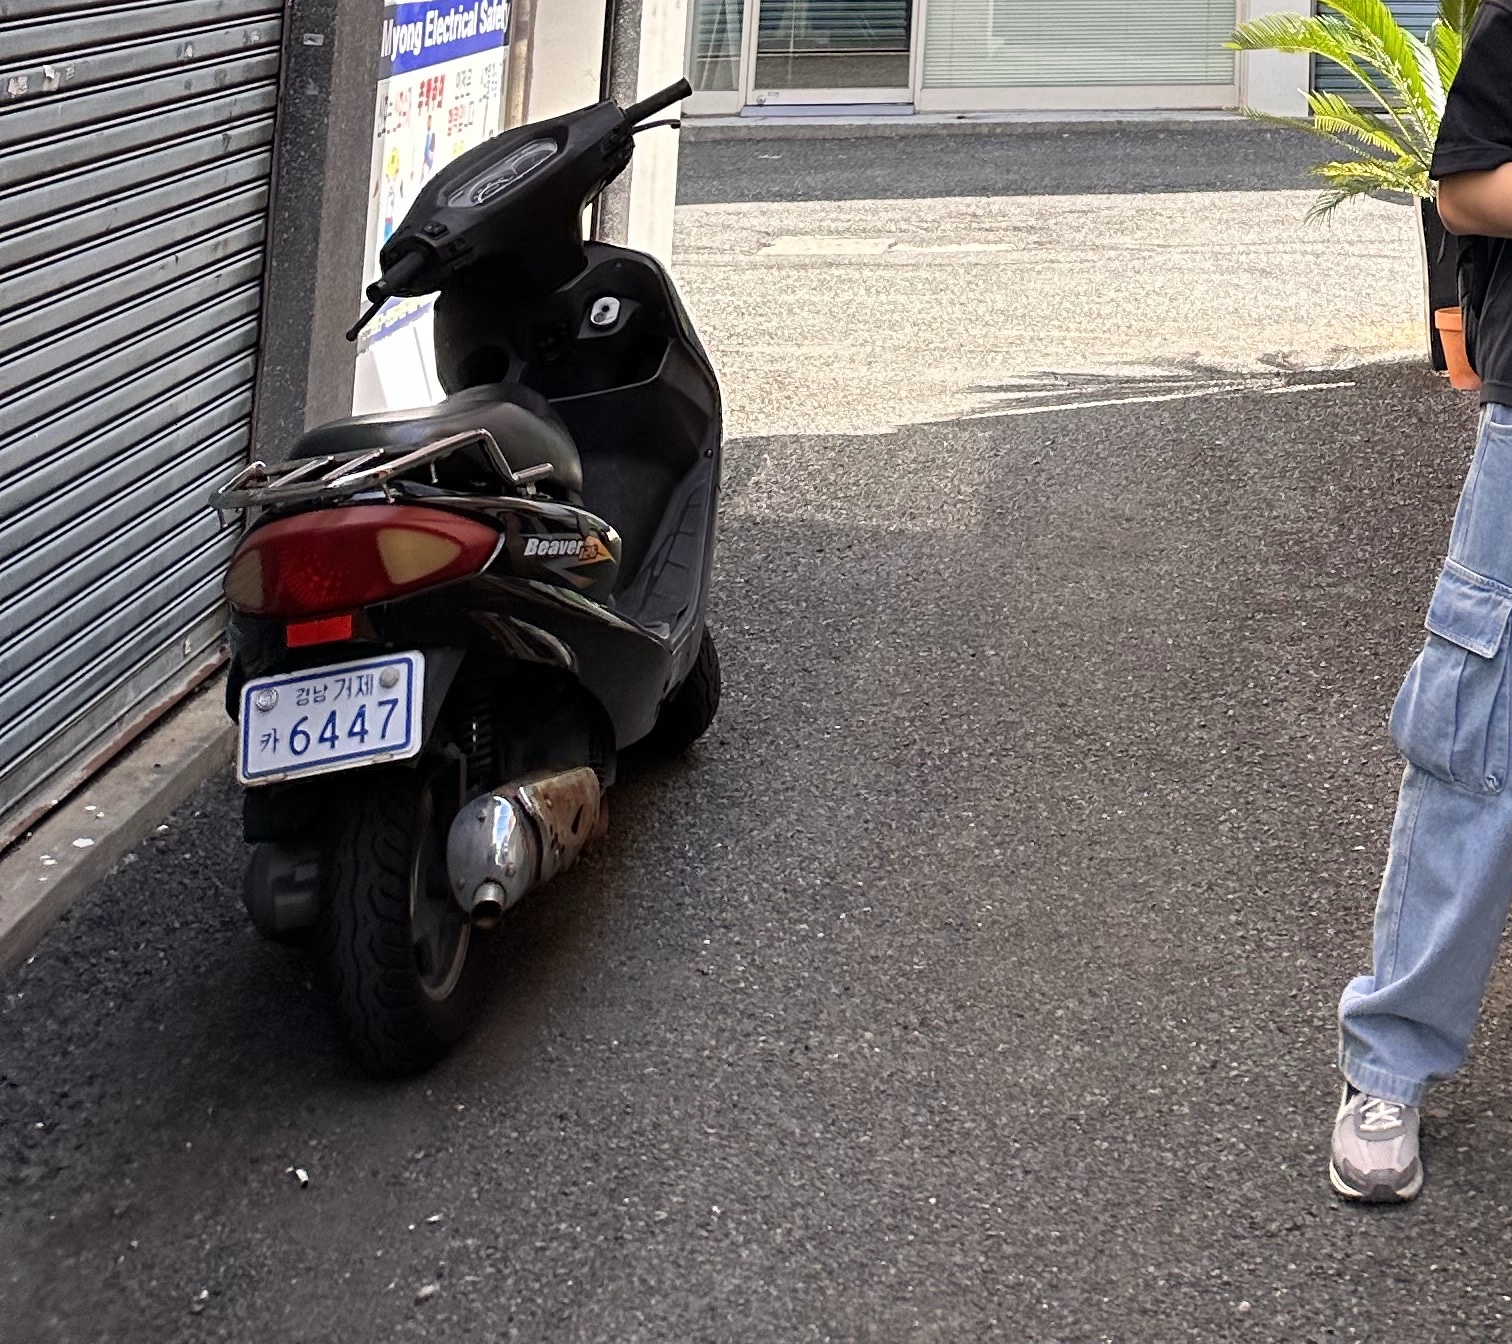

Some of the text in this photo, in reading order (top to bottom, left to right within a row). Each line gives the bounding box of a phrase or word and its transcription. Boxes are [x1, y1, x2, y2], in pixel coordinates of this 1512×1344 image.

[424, 2, 479, 48] Electrical
[524, 538, 584, 556] Beaver
[296, 673, 374, 706] 경남 거제
[259, 697, 399, 756] 카 6447
